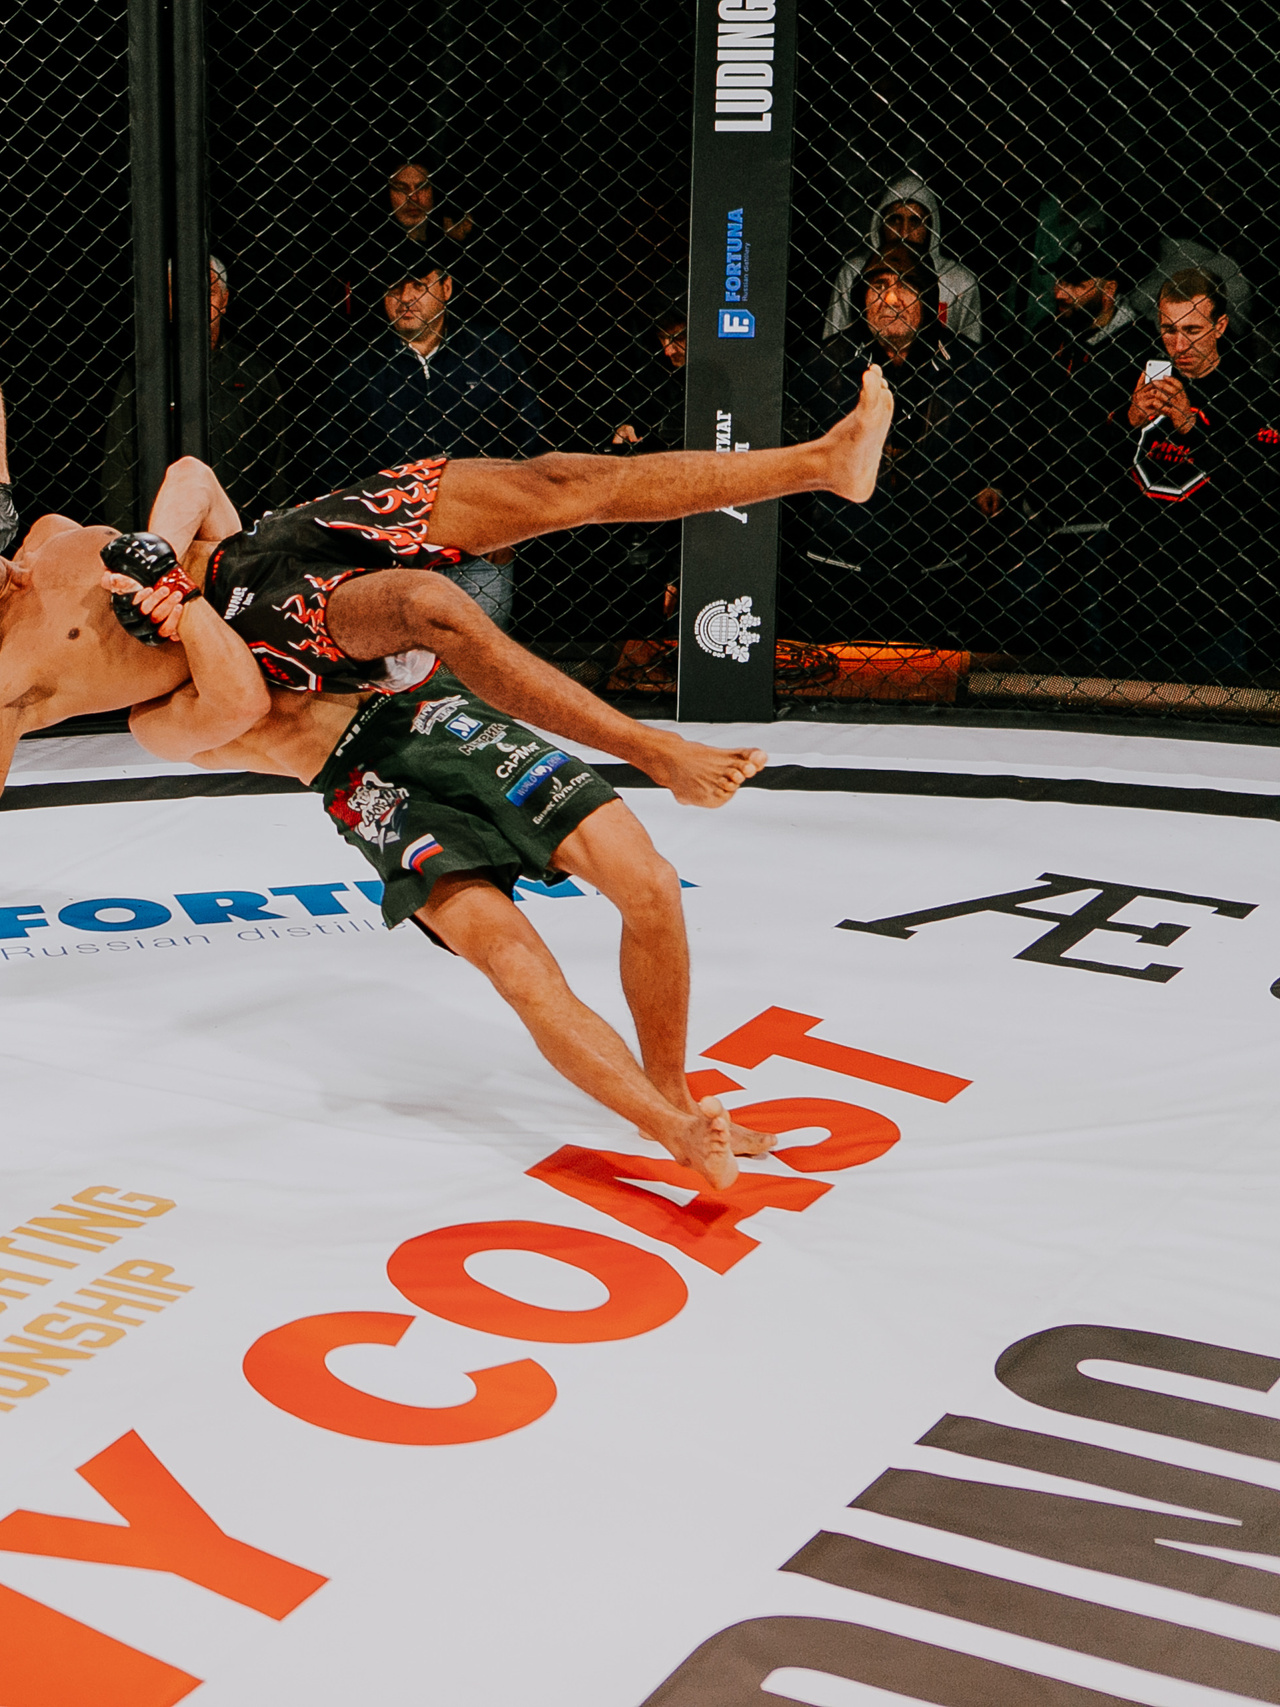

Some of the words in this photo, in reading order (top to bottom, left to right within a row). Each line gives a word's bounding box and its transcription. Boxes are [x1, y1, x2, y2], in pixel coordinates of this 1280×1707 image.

[714, 0, 776, 132] LUDING
[724, 208, 744, 303] FORTUNA
[716, 410, 732, 453] ТИАГ
[0, 933, 211, 960] Russian
[242, 1005, 974, 1447] COAST
